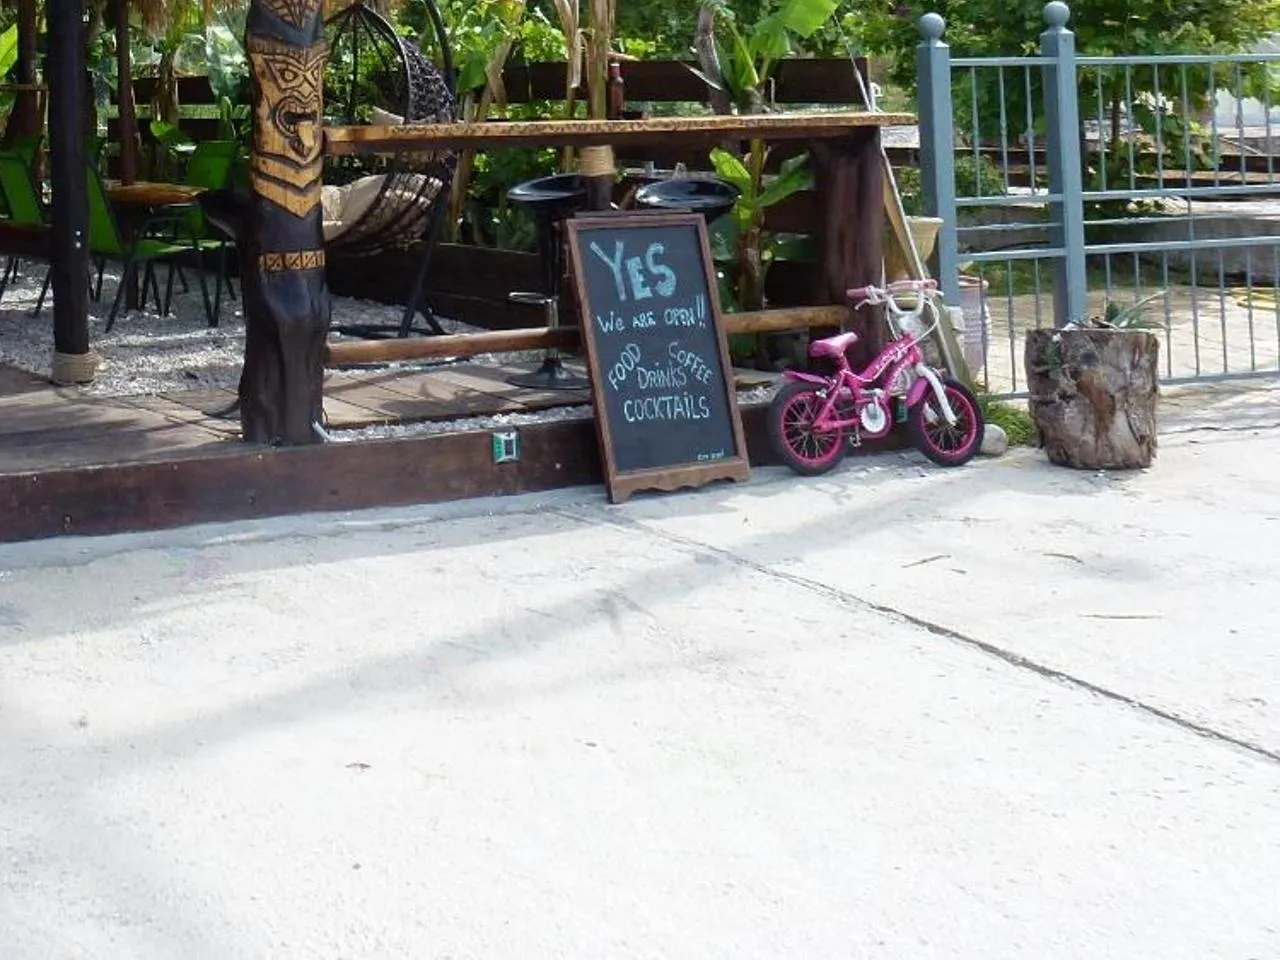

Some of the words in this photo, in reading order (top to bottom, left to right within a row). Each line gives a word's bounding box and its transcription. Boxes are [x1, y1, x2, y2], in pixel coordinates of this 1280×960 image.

[589, 240, 677, 301] YES
[632, 311, 656, 328] ARE
[608, 343, 641, 391] FOOD
[668, 341, 714, 385] COFFEE
